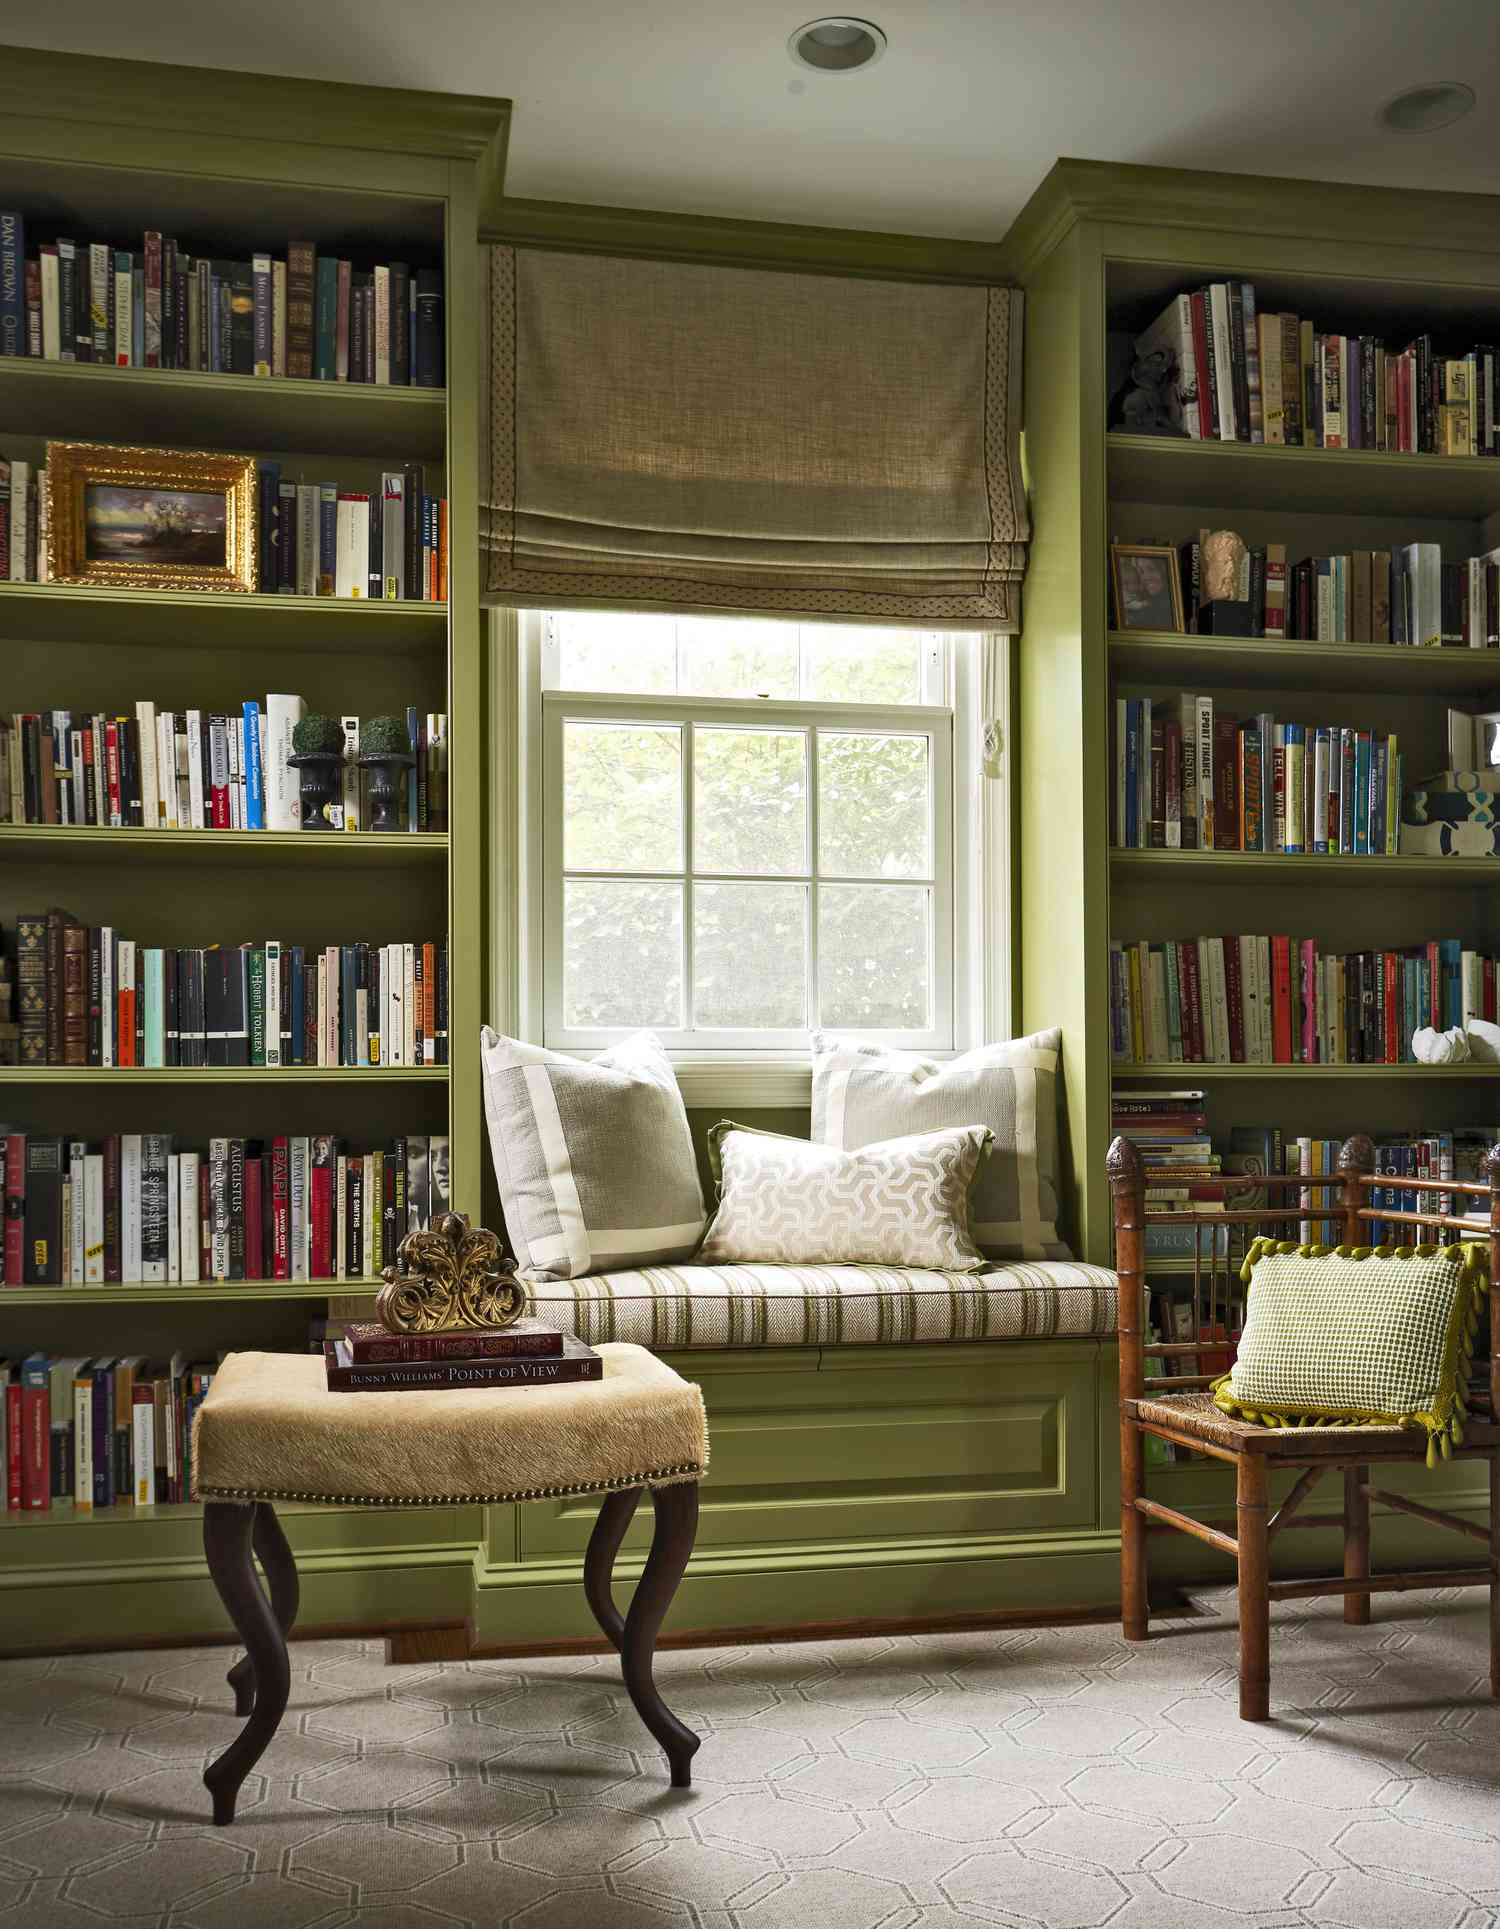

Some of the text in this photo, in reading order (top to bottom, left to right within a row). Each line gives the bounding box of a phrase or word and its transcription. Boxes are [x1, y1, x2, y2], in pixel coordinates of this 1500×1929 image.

[2, 215, 17, 302] DAN BROWN
[118, 280, 129, 319] STEPHEN
[256, 305, 267, 350] FLANDERS
[1191, 544, 1200, 585] BEOWULF
[1202, 711, 1210, 779] SPORT FINANCE
[1184, 747, 1195, 792] HISTORY
[1274, 751, 1284, 815] TELL WIN
[91, 948, 100, 1001] SHAKESPEARE
[251, 975, 264, 1009] HOBBIT
[254, 1014, 262, 1052] TOLKIEN
[215, 1142, 225, 1223] ABSOLUTELY AMERICAN
[231, 1144, 242, 1213] AUGUSTUS
[272, 1146, 288, 1200] PAPI
[293, 1153, 303, 1182] ROYAL
[1384, 1167, 1397, 1205] Cna
[1403, 1167, 1414, 1199] Tuey
[149, 1137, 161, 1242] BRUCE SPRINGSTEEN
[293, 1185, 303, 1210] DUTY
[36, 1241, 44, 1263] USED
[215, 1226, 225, 1272] DAVID LIPSKY
[1152, 1232, 1193, 1249] YRUS
[350, 1374, 387, 1386] BUNNY
[448, 1364, 560, 1383] POINT OF VIEW
